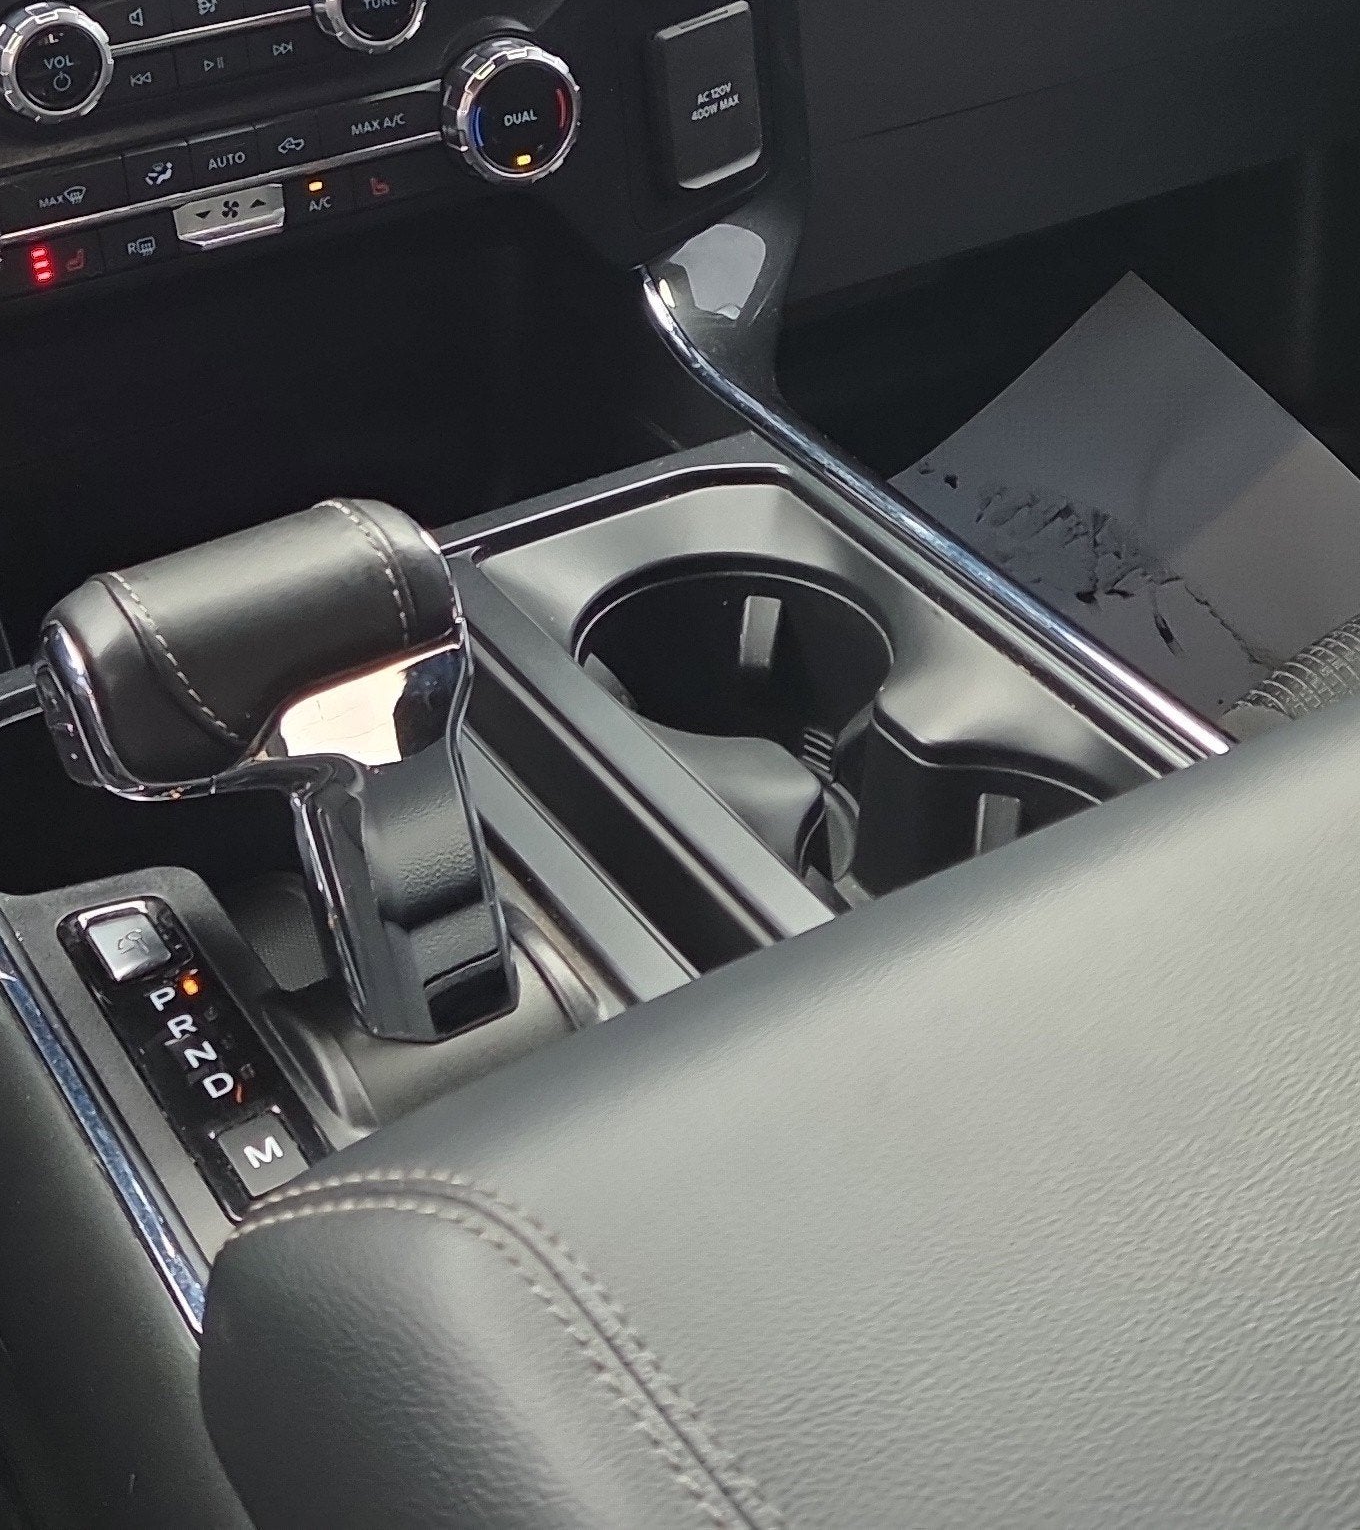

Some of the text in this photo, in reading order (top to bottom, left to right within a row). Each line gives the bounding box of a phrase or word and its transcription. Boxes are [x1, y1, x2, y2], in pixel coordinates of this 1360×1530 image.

[43, 54, 74, 69] VOL
[351, 113, 407, 136] MAX A/C
[503, 108, 538, 126] DUAL
[207, 152, 246, 171] AUTO
[38, 195, 66, 210] MAX
[308, 195, 332, 212] A/C
[149, 986, 176, 1012] P
[166, 1014, 198, 1039] R
[184, 1040, 218, 1069] N
[202, 1072, 234, 1099] D
[243, 1136, 284, 1169] M
